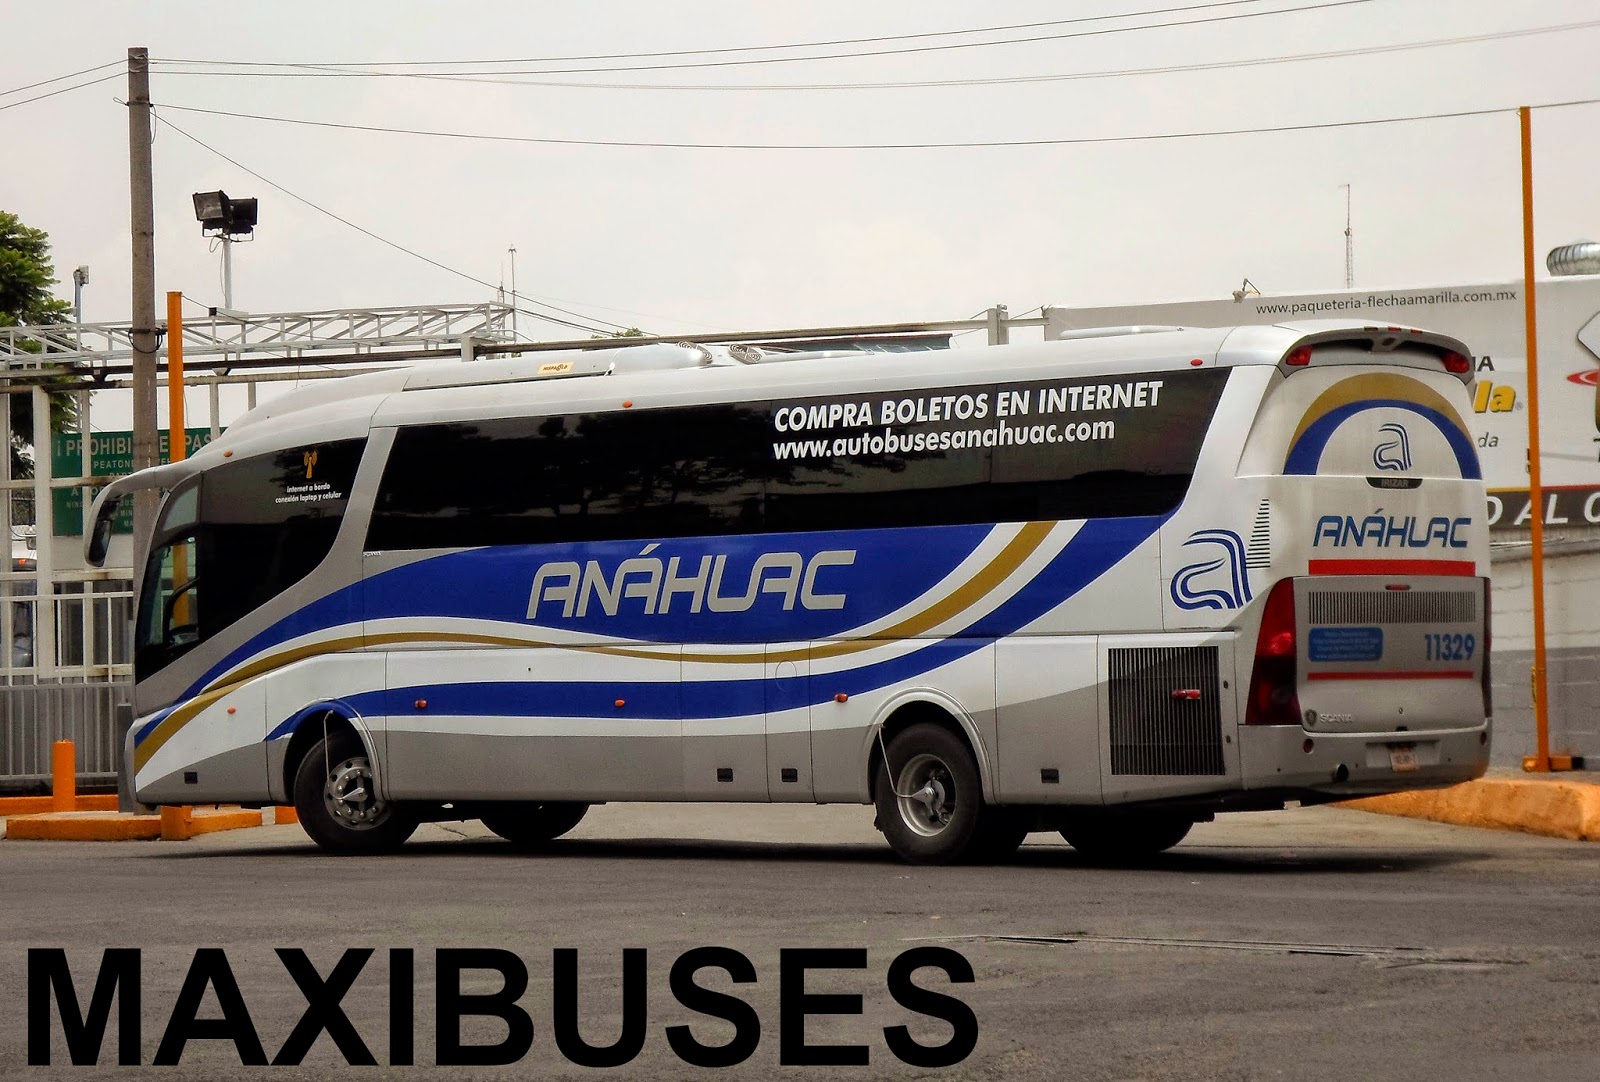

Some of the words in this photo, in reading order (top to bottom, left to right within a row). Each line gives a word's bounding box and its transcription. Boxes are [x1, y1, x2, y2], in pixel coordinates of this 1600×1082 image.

[1256, 289, 1517, 315] www.paqueteria-flechaamarilla.com.mx
[774, 402, 873, 432] COMPRA
[880, 393, 989, 426] BOLETOS
[996, 390, 1030, 417] EN
[1038, 381, 1164, 413] INTERNET
[773, 417, 1116, 460] www.autobusesanahuac.com
[1424, 633, 1476, 661] 11329
